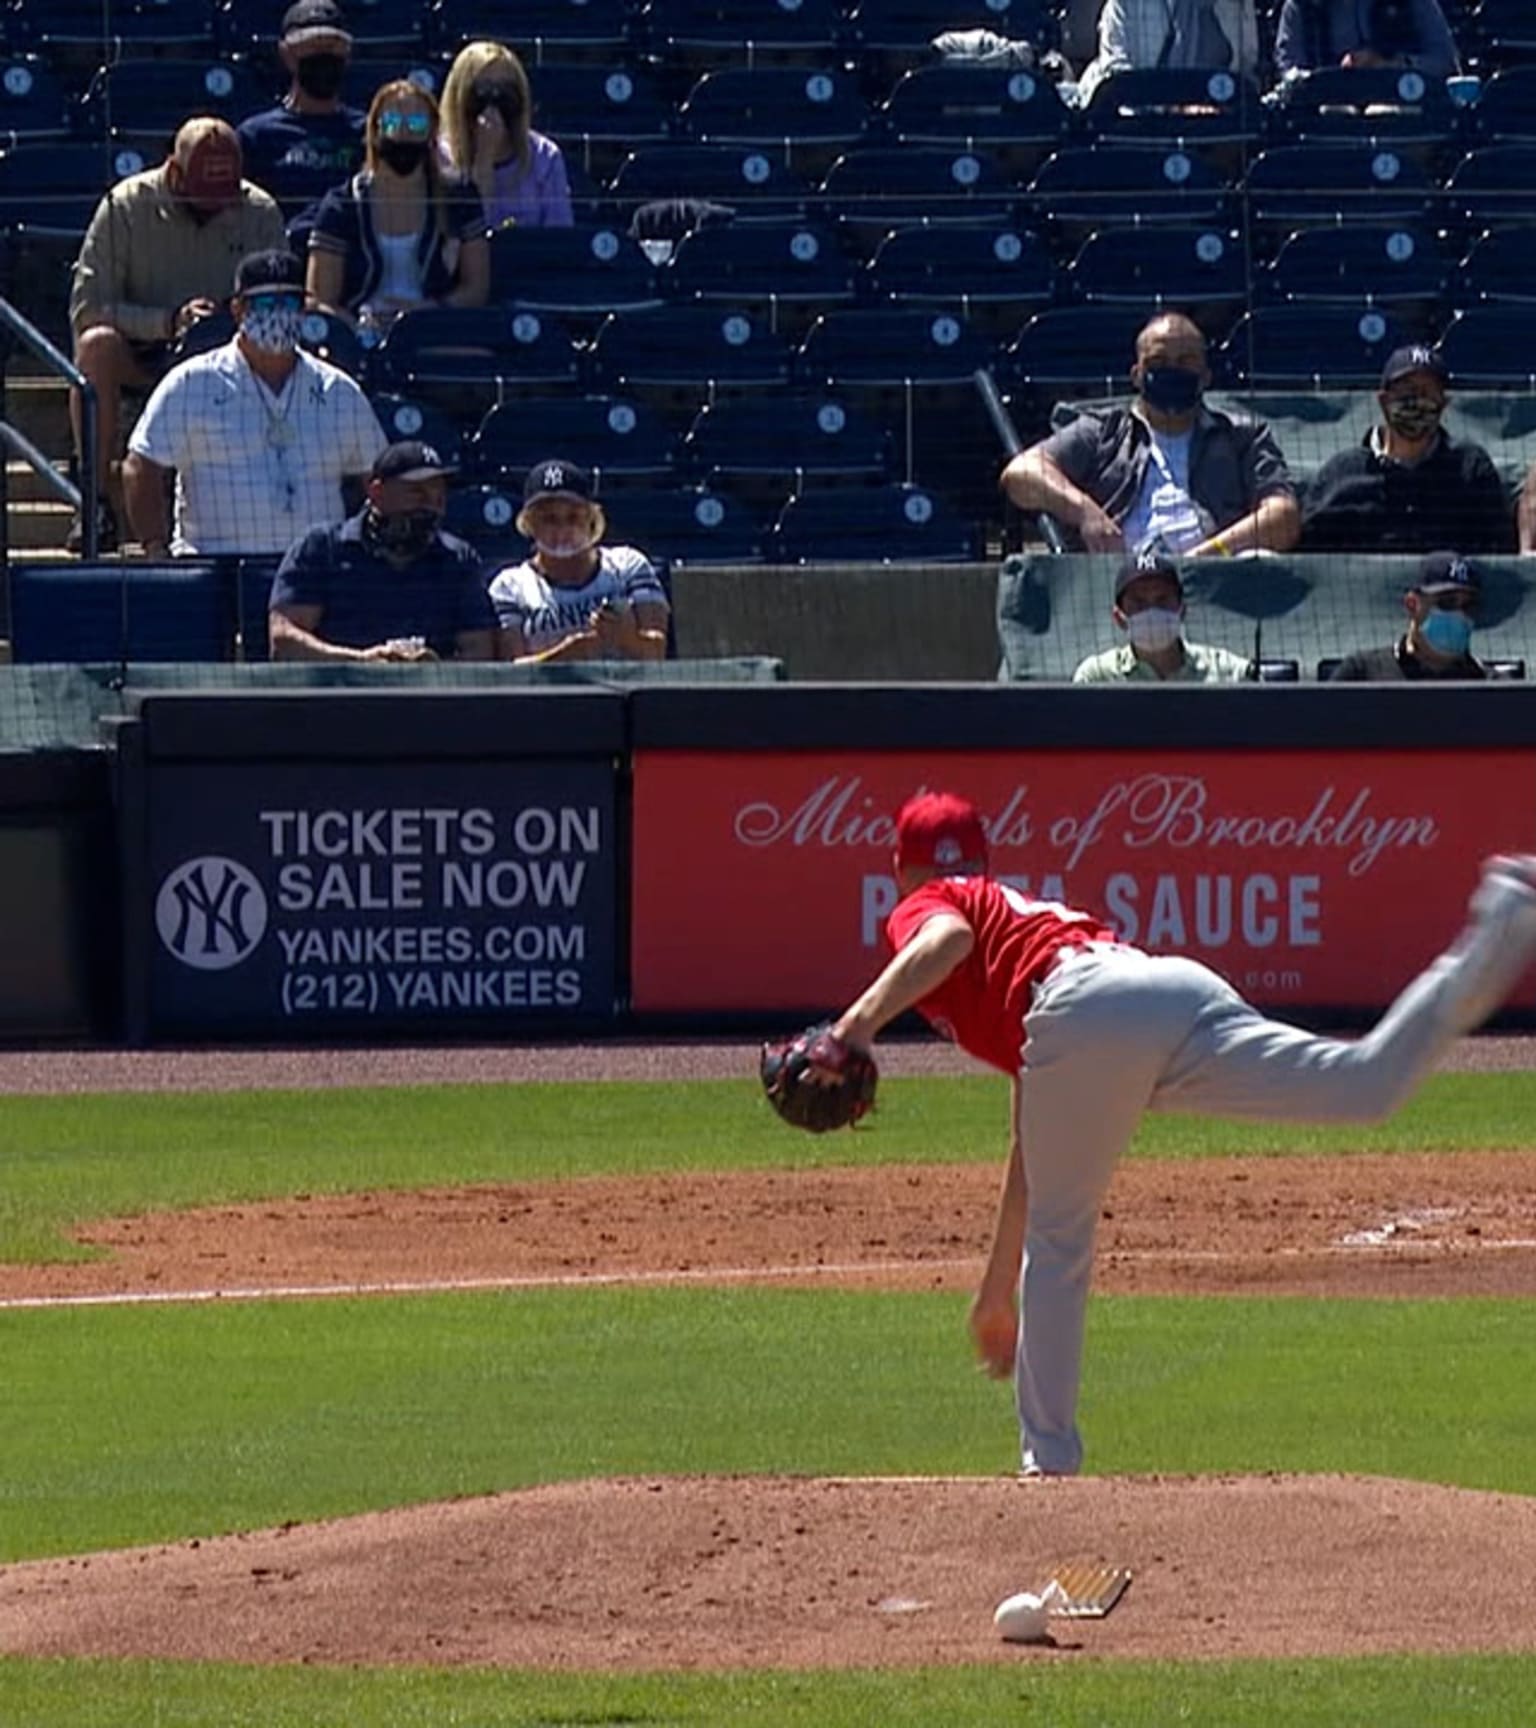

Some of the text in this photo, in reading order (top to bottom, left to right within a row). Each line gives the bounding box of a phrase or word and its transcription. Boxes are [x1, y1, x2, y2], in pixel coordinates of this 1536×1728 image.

[260, 806, 599, 857] TICKETS ON
[1050, 783, 1128, 871] of
[1123, 773, 1440, 877] Brooklyn
[278, 861, 586, 911] SALE NOW
[1105, 872, 1323, 947] SAUCE
[277, 925, 585, 965] YANKEES.COM
[281, 970, 582, 1014] (212) YANKEES
